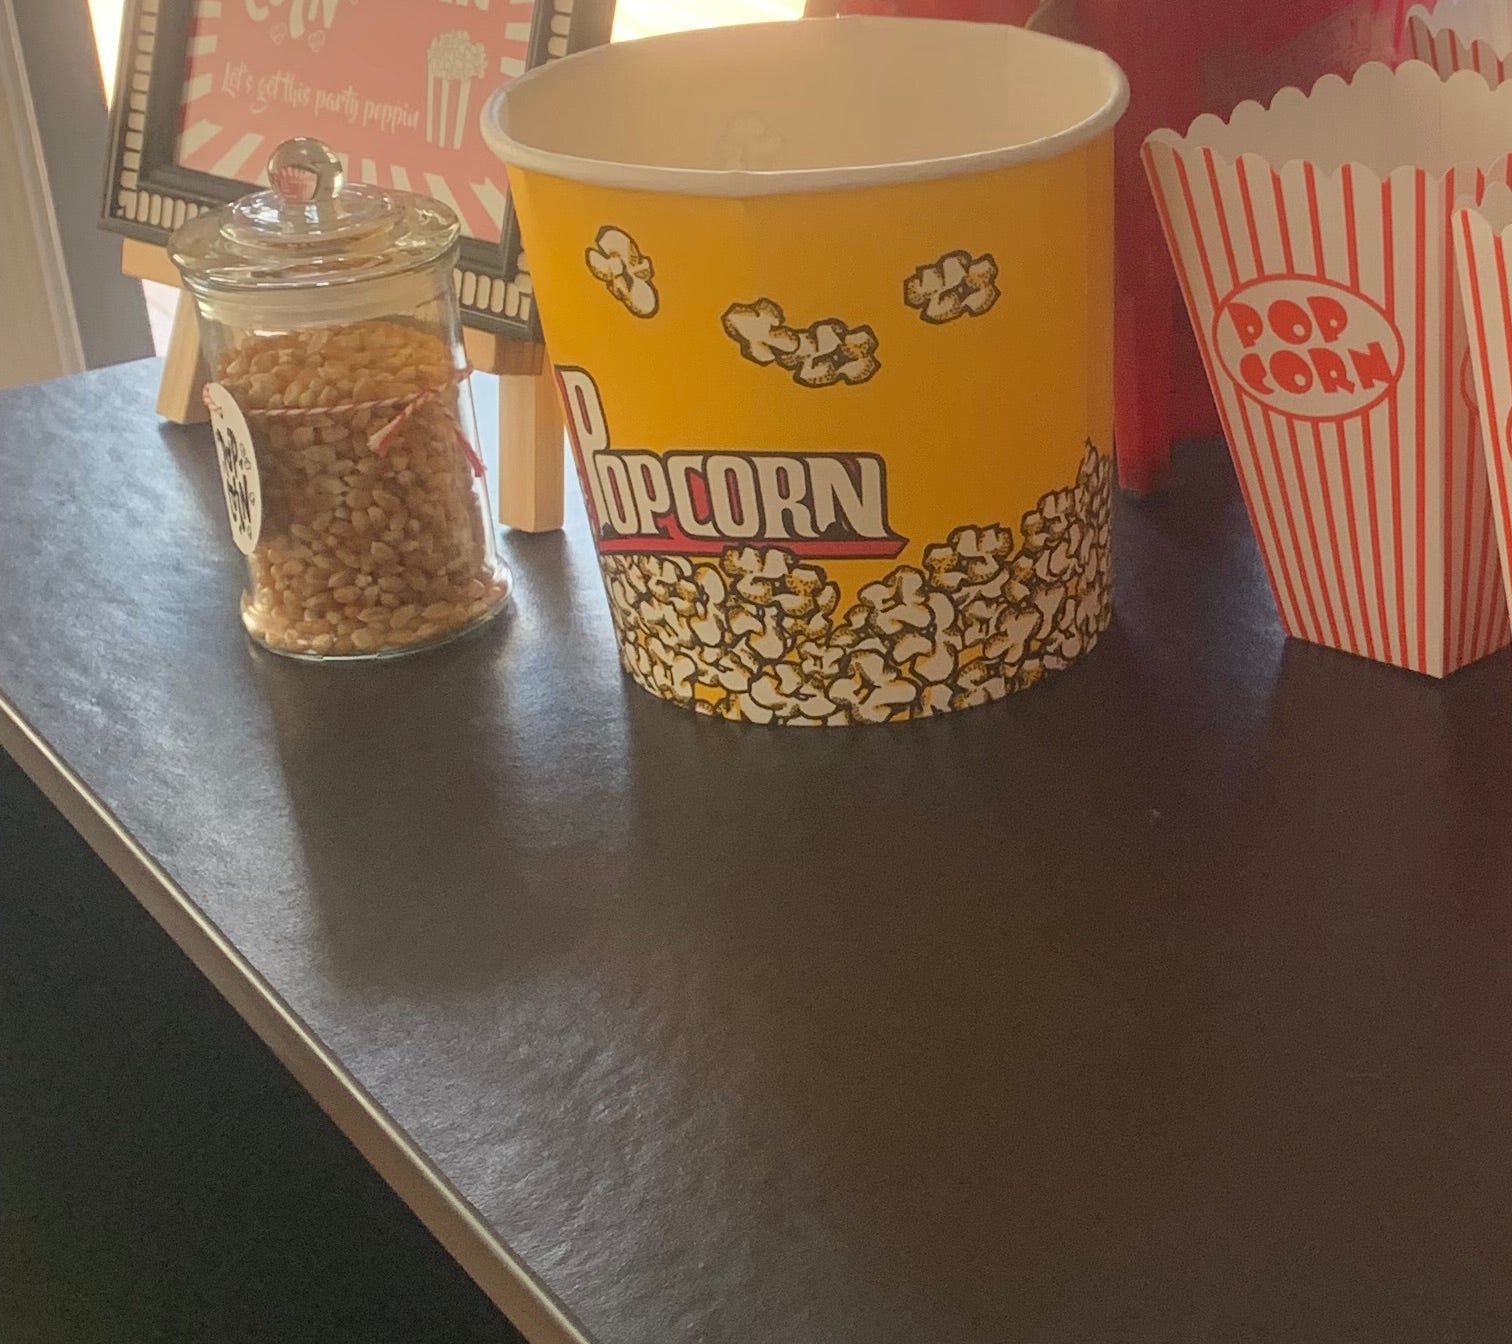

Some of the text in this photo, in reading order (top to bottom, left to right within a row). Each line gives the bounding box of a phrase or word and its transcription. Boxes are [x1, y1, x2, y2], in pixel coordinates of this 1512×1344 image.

[314, 84, 360, 123] party
[1225, 295, 1348, 349] POP
[1239, 340, 1395, 396] CORN
[556, 366, 891, 540] POPCORN
